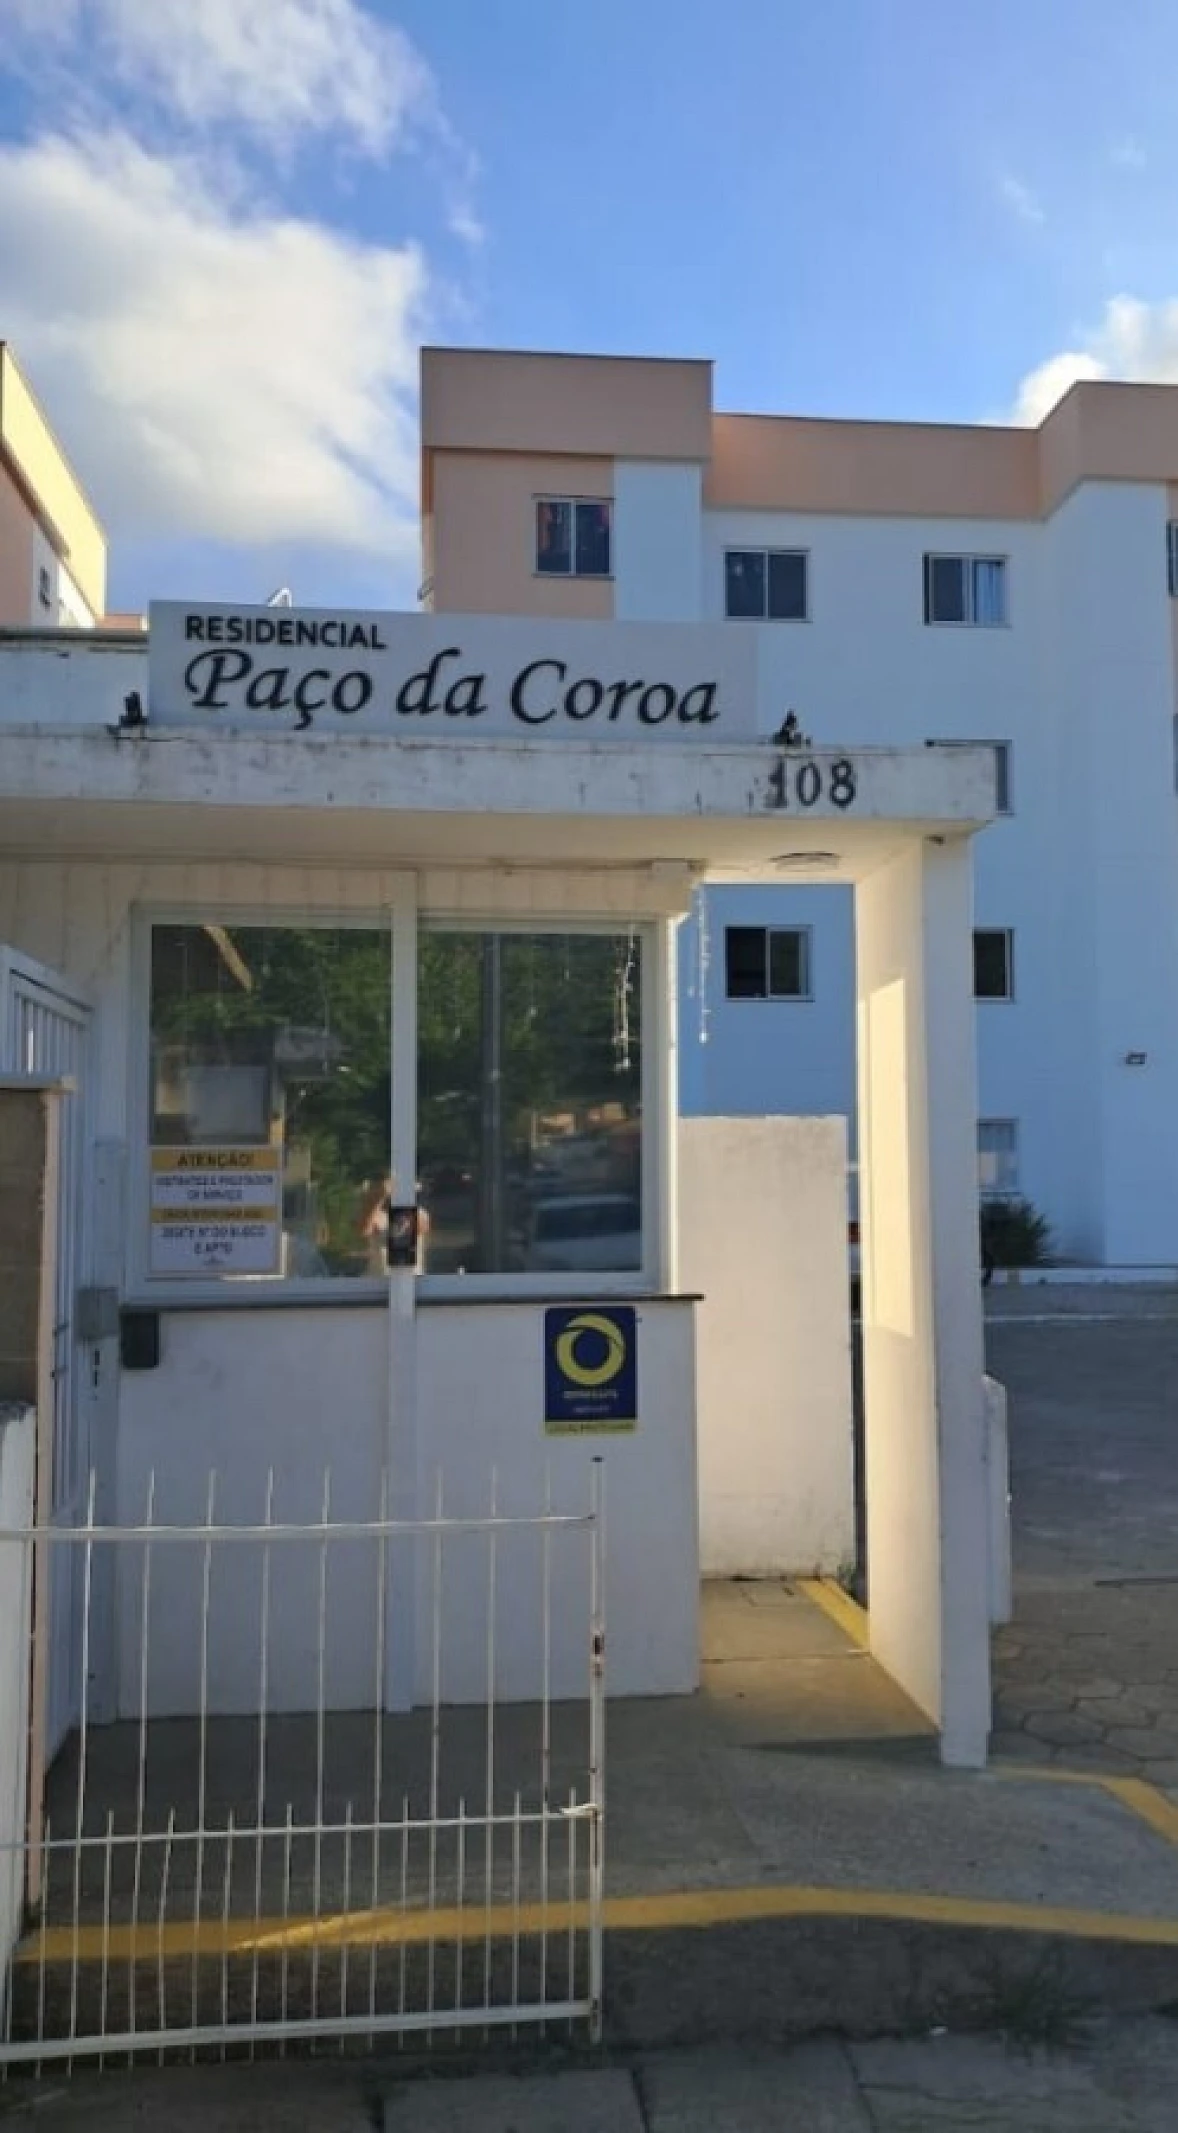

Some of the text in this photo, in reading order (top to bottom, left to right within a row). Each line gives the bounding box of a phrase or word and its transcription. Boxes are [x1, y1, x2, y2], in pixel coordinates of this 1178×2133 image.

[184, 615, 387, 651] RESIDENCIAL
[184, 647, 720, 730] Paço da Coroa
[763, 755, 857, 809] 108
